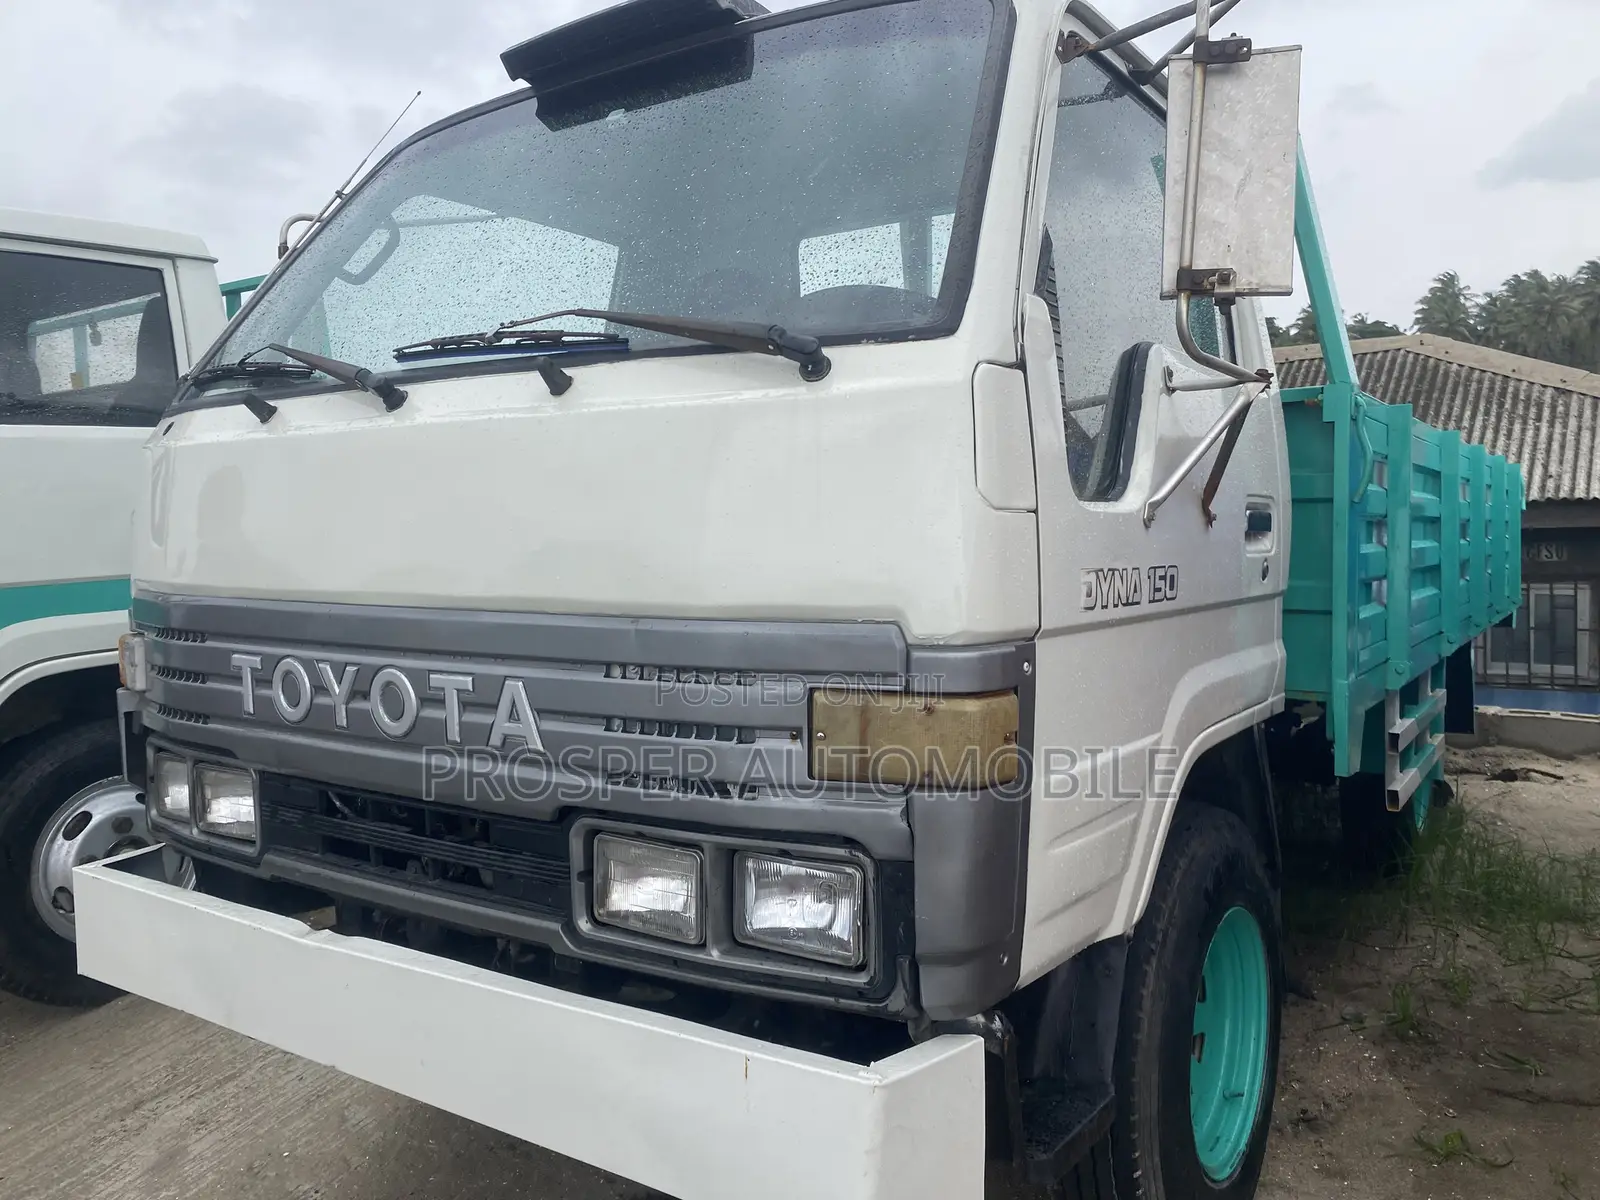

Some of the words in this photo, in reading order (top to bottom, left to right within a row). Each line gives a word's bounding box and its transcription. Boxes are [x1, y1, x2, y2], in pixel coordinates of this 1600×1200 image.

[1080, 567, 1142, 611] DYNA
[1147, 565, 1179, 604] 150
[230, 652, 547, 756] TOYOTA
